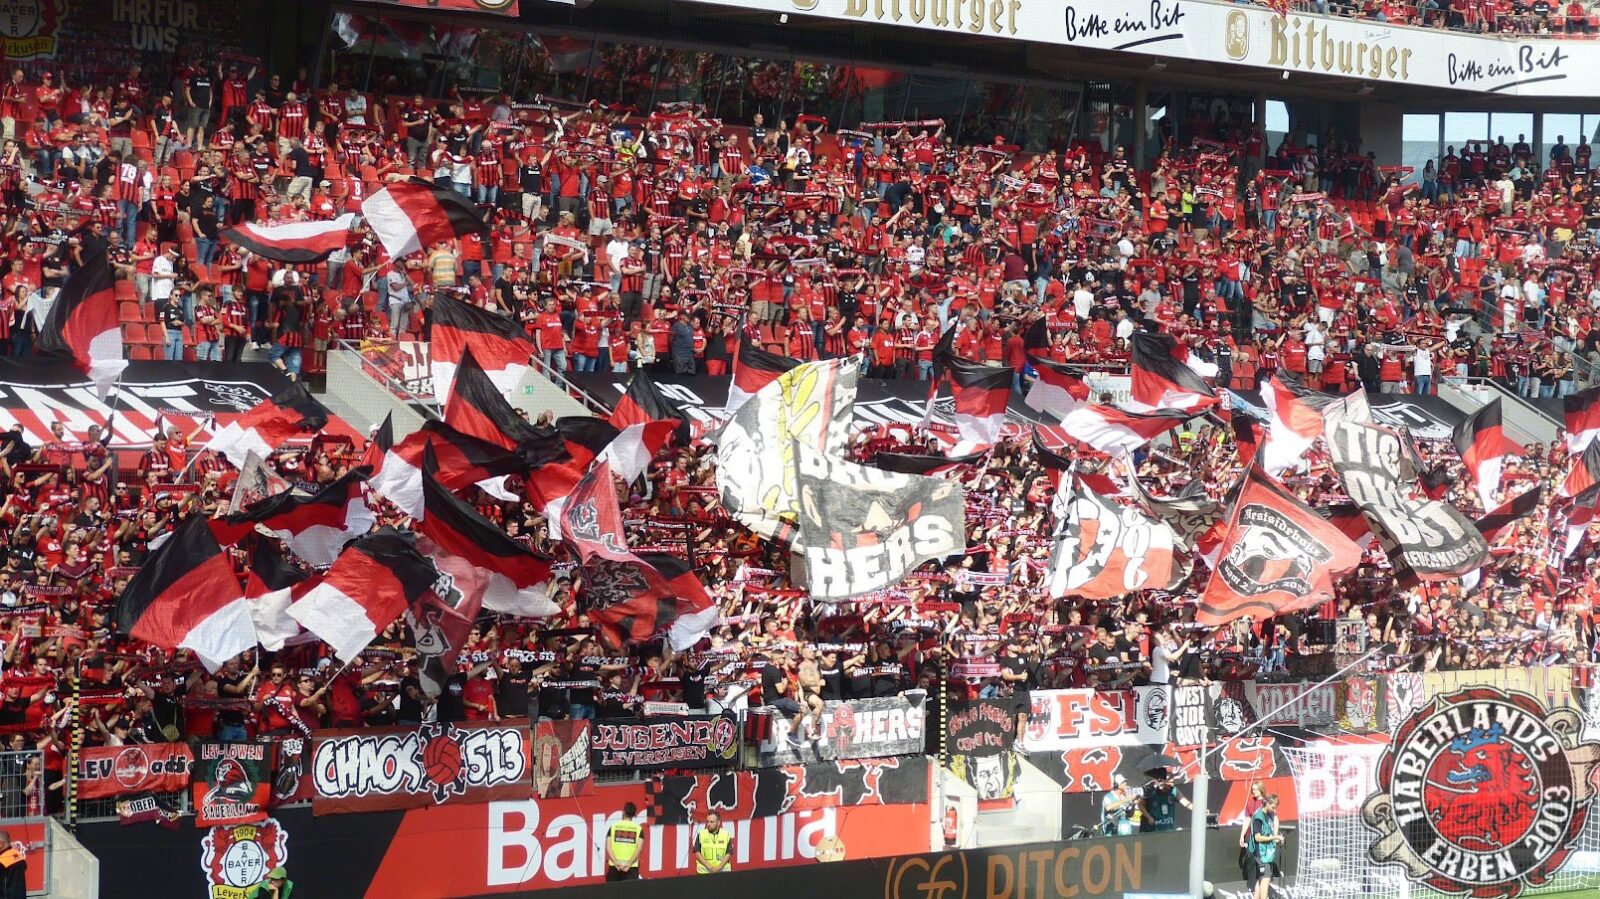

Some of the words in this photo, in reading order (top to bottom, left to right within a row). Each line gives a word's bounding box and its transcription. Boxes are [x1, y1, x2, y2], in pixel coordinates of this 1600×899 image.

[1064, 6, 1109, 42] Bitte
[1113, 20, 1148, 35] ein
[1150, 0, 1186, 31] Bit
[131, 24, 179, 53] UNS
[1268, 14, 1413, 81] Bitburger
[1448, 53, 1484, 84] Bitte
[1487, 59, 1515, 77] ein
[1519, 45, 1569, 73] Bit
[806, 514, 953, 600] HERS
[1402, 537, 1484, 568] LEVERKUSEN
[1174, 686, 1205, 707] WEST
[853, 706, 925, 744] HERS
[1056, 691, 1139, 738] FSI
[1175, 706, 1206, 727] SIDE
[592, 720, 714, 751] JUGEND
[201, 743, 264, 761] LEV-LÖWEN
[314, 735, 423, 797] CHAOS
[463, 728, 525, 787] 513
[602, 746, 707, 766] LEVERKUSEN
[202, 802, 260, 821] SAUERLAND
[235, 827, 255, 838] 1904
[227, 858, 261, 869] BAYER
[241, 843, 249, 885] BAYER
[985, 841, 1143, 899] DITCON
